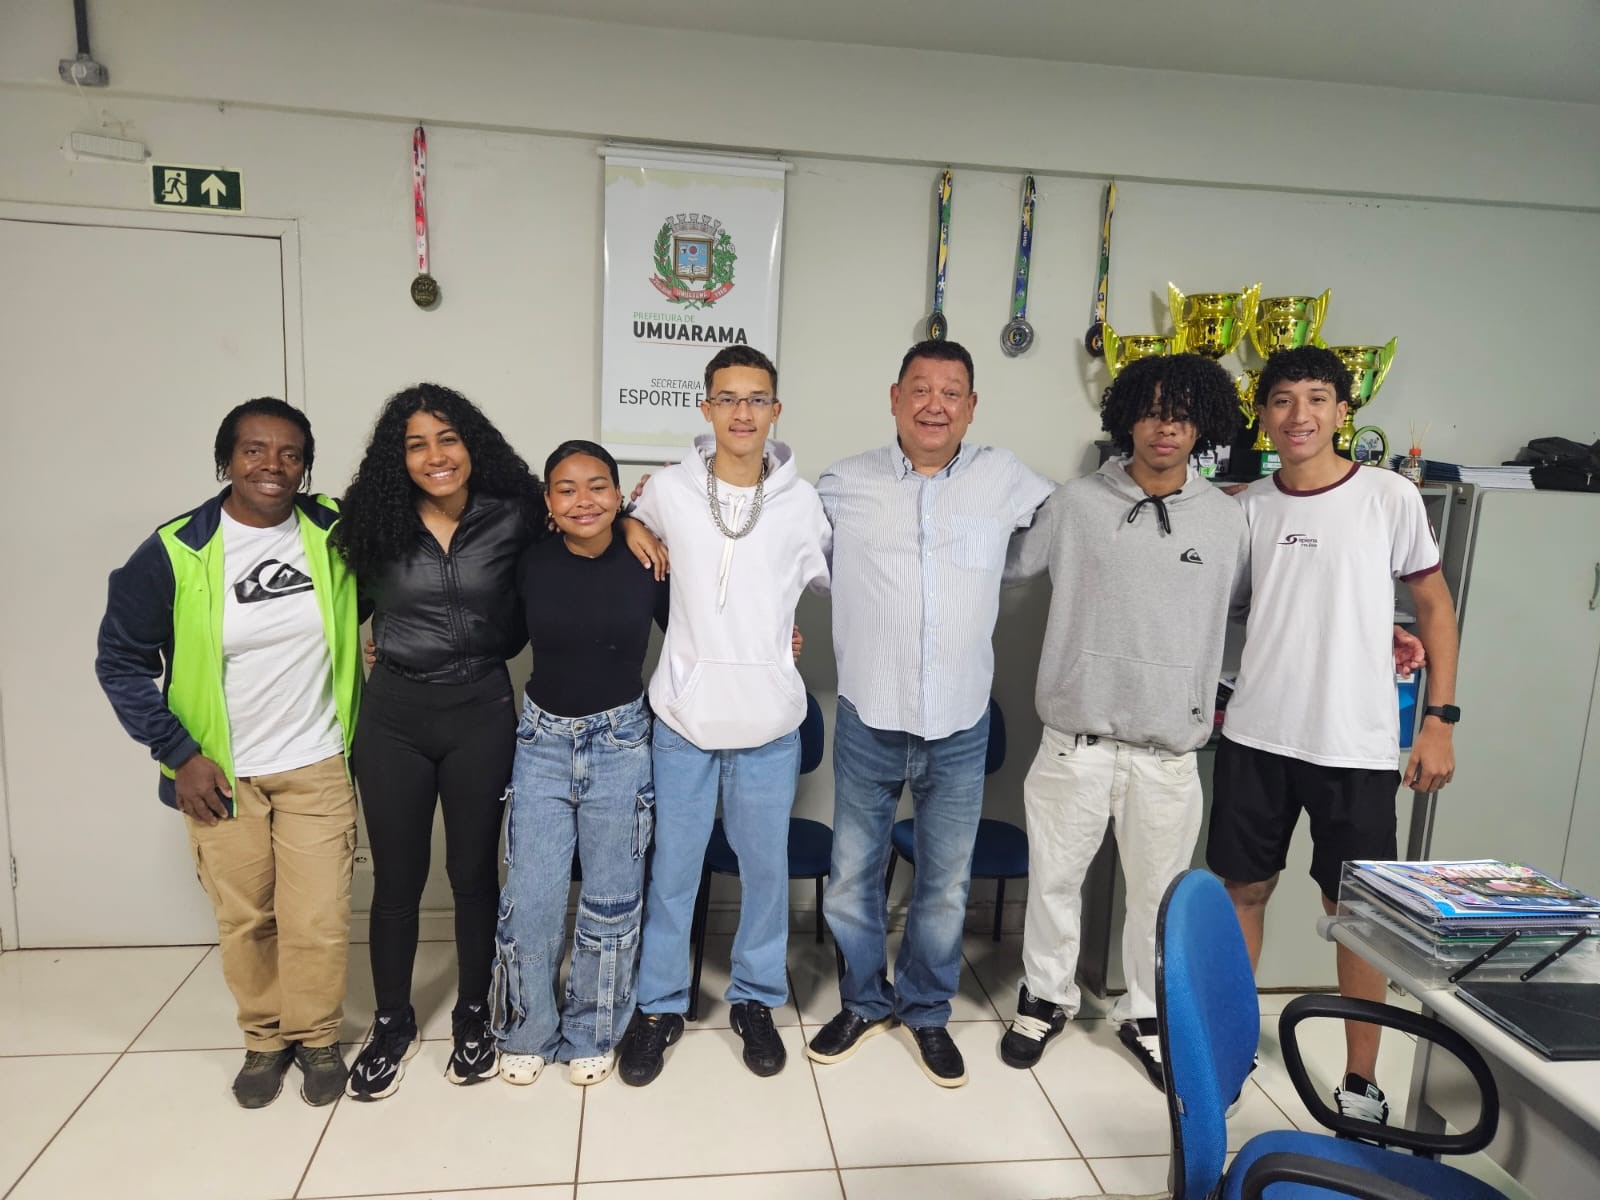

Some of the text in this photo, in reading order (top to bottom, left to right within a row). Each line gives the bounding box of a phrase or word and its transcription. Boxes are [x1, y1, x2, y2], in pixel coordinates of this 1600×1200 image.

[633, 311, 696, 323] PREFEITURA DE
[633, 321, 748, 344] UMUARAMA
[650, 378, 701, 390] SECRETARIA
[619, 388, 691, 408] ESPORTE
